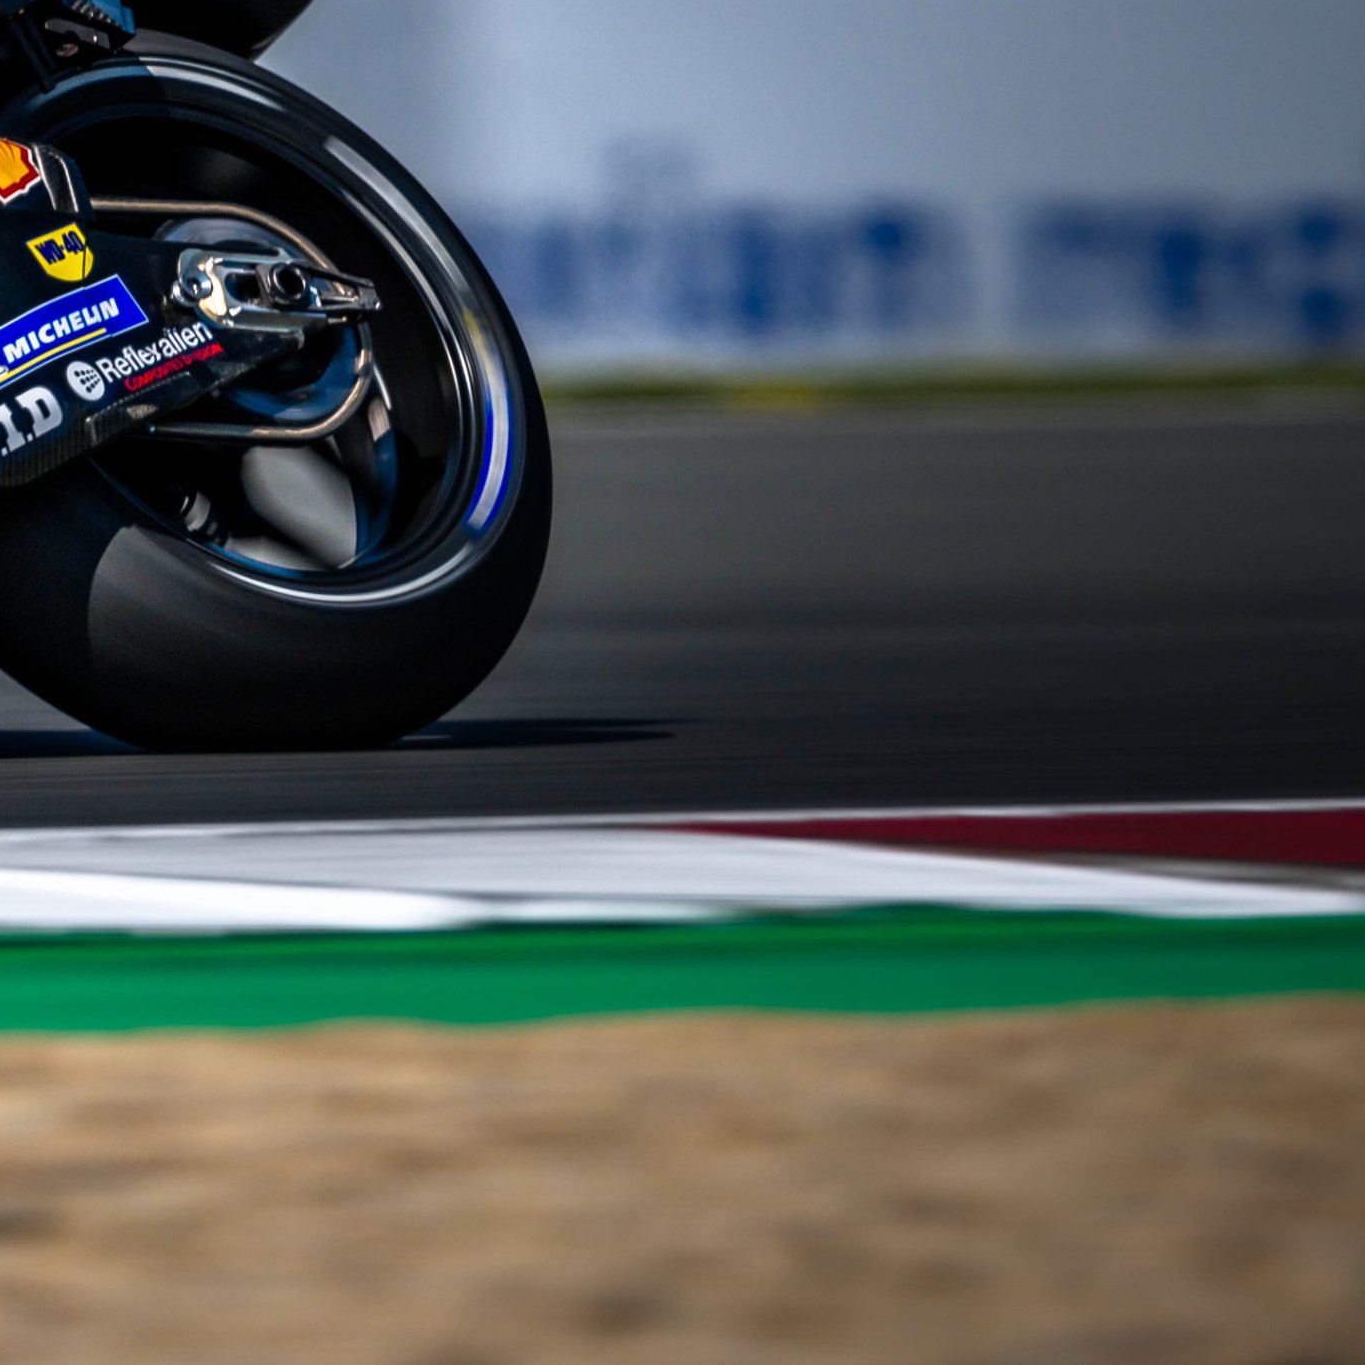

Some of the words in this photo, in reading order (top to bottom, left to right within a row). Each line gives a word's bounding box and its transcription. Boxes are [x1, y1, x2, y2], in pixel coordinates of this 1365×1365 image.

[34, 230, 85, 265] WD-40
[2, 297, 120, 364] MICHELIN
[95, 321, 213, 383] Reflexallen
